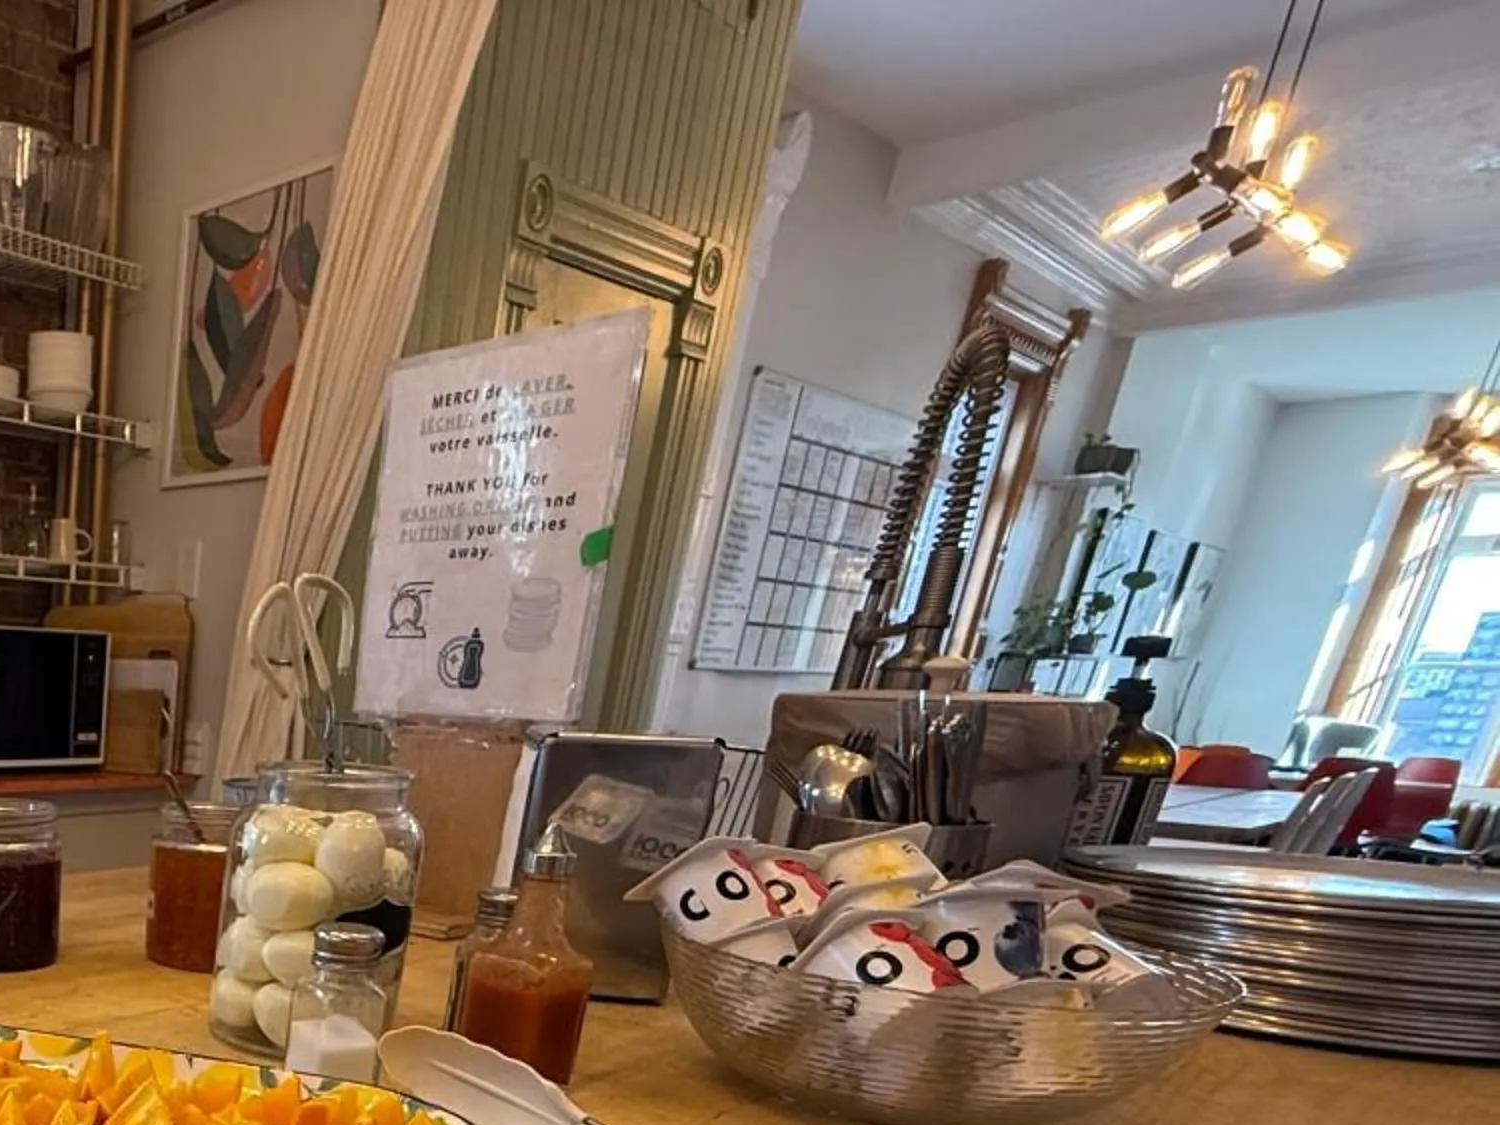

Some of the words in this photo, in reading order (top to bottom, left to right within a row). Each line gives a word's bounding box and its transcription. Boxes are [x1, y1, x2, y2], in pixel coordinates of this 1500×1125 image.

[432, 388, 479, 410] MERCI
[481, 409, 497, 425] et
[429, 438, 470, 454] votre
[427, 480, 477, 497] THANK
[483, 475, 516, 491] YOU
[521, 472, 548, 491] for
[467, 523, 503, 541] your
[448, 546, 494, 561] away.
